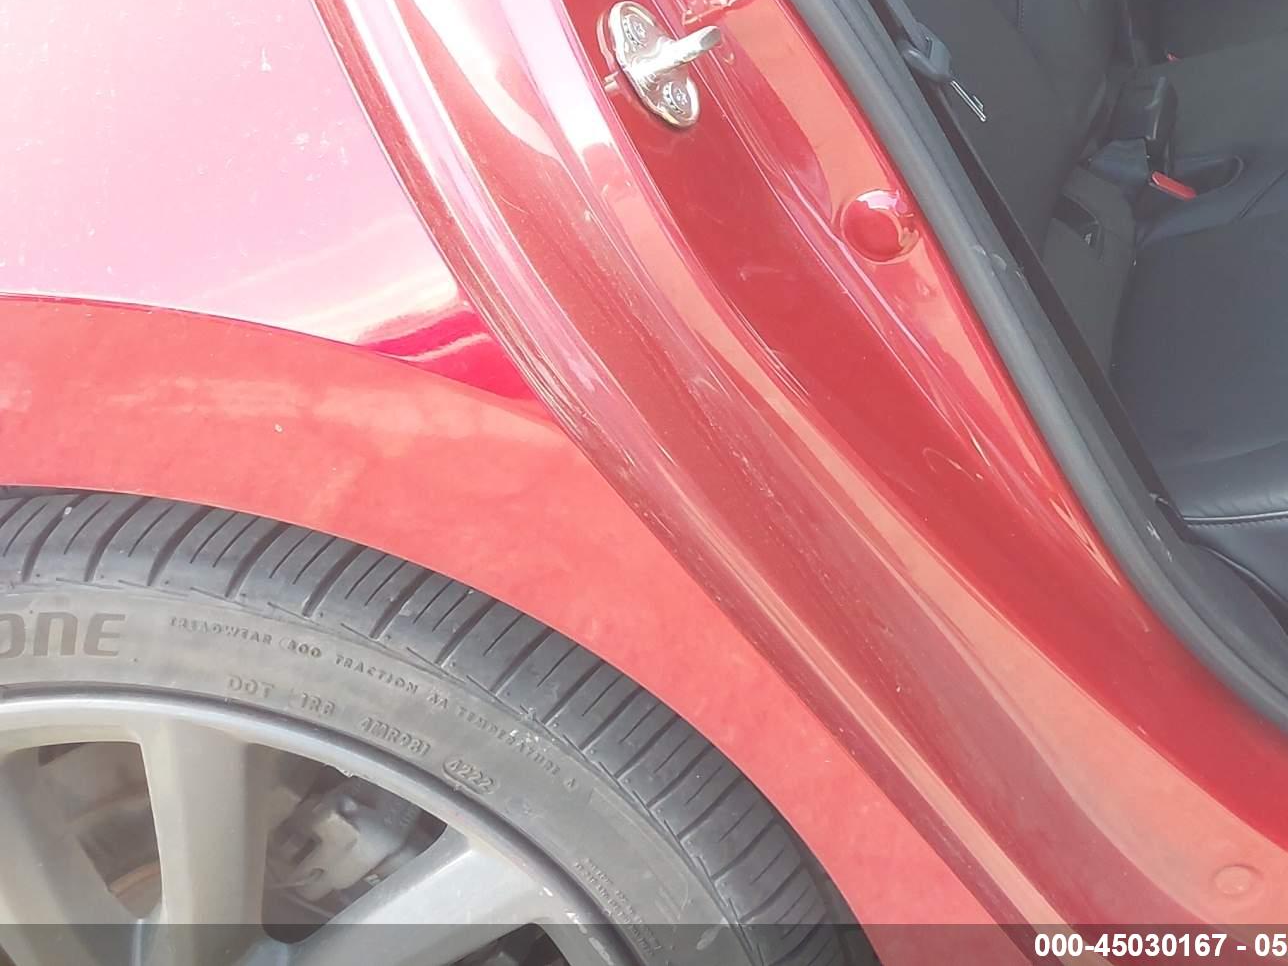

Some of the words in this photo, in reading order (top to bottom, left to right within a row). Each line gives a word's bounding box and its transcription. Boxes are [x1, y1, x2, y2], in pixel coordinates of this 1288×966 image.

[226, 674, 276, 699] DOT
[334, 653, 419, 695] TRACTION
[455, 705, 561, 776] TEMPERATURE
